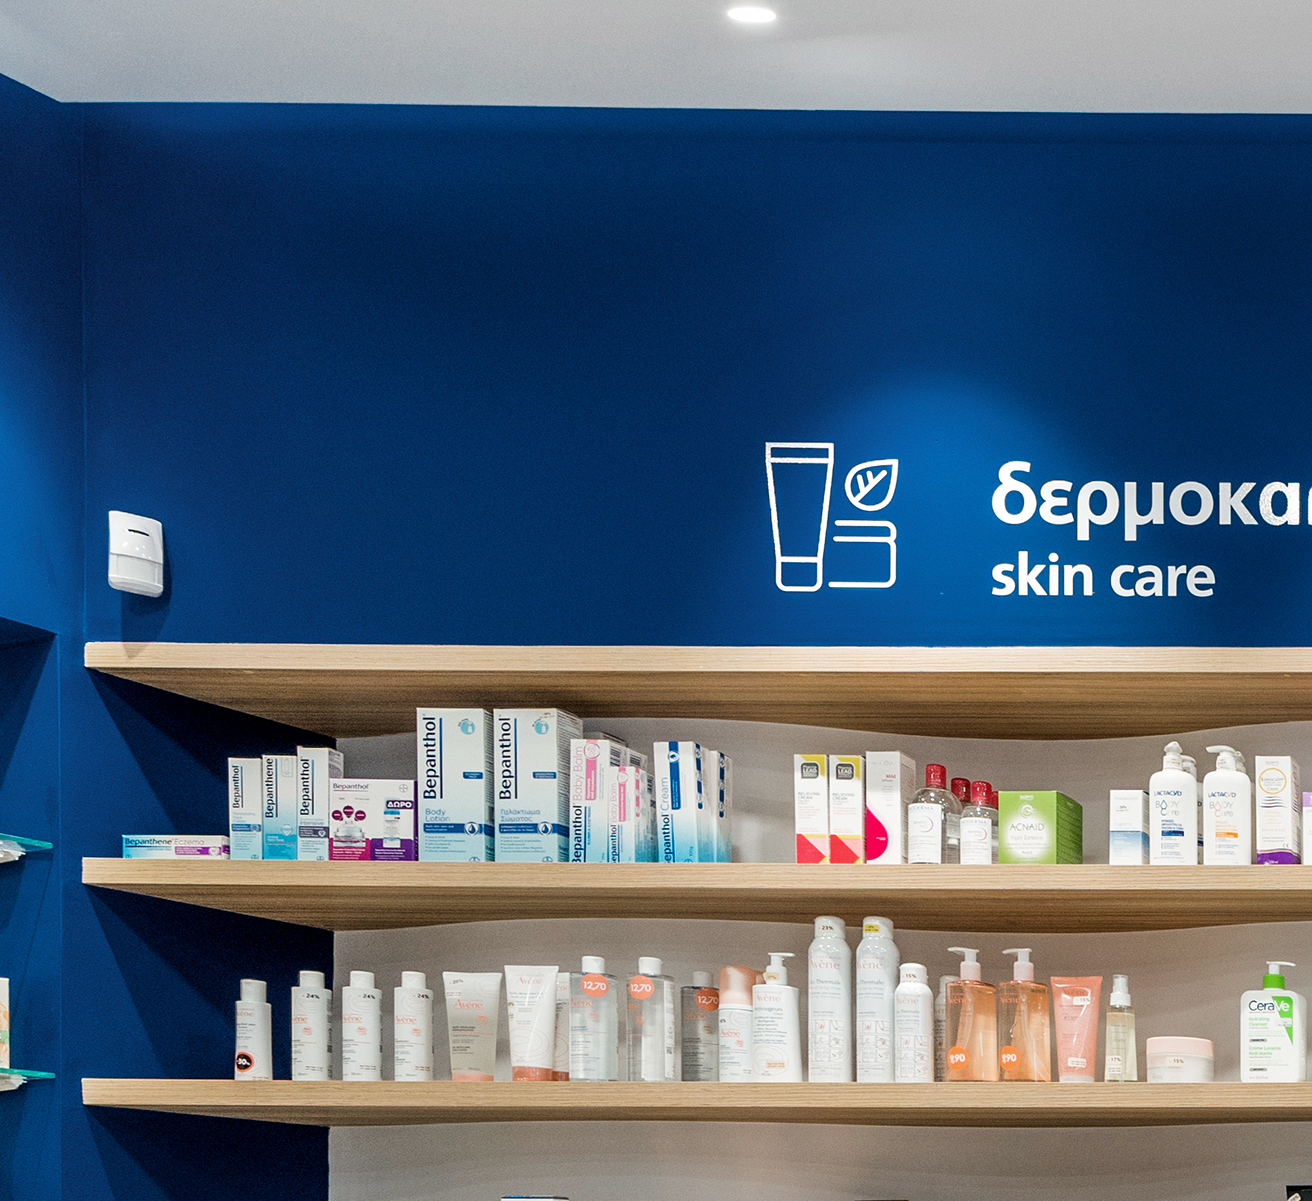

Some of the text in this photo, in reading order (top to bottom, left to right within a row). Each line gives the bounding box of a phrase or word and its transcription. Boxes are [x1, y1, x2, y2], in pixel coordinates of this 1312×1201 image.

[991, 552, 1216, 598] skin care
[423, 716, 437, 800] Bepanthol
[499, 717, 512, 801] Bepanthol
[232, 765, 240, 809] Bepanthol
[265, 758, 275, 819] Bepanthene
[299, 759, 310, 816] Bepanthol
[333, 782, 369, 791] Bepanthol
[387, 801, 413, 809] ΔΩΡΟ
[583, 981, 607, 991] 12,70
[630, 983, 652, 992] 12,70
[1248, 999, 1291, 1012] CeraVe
